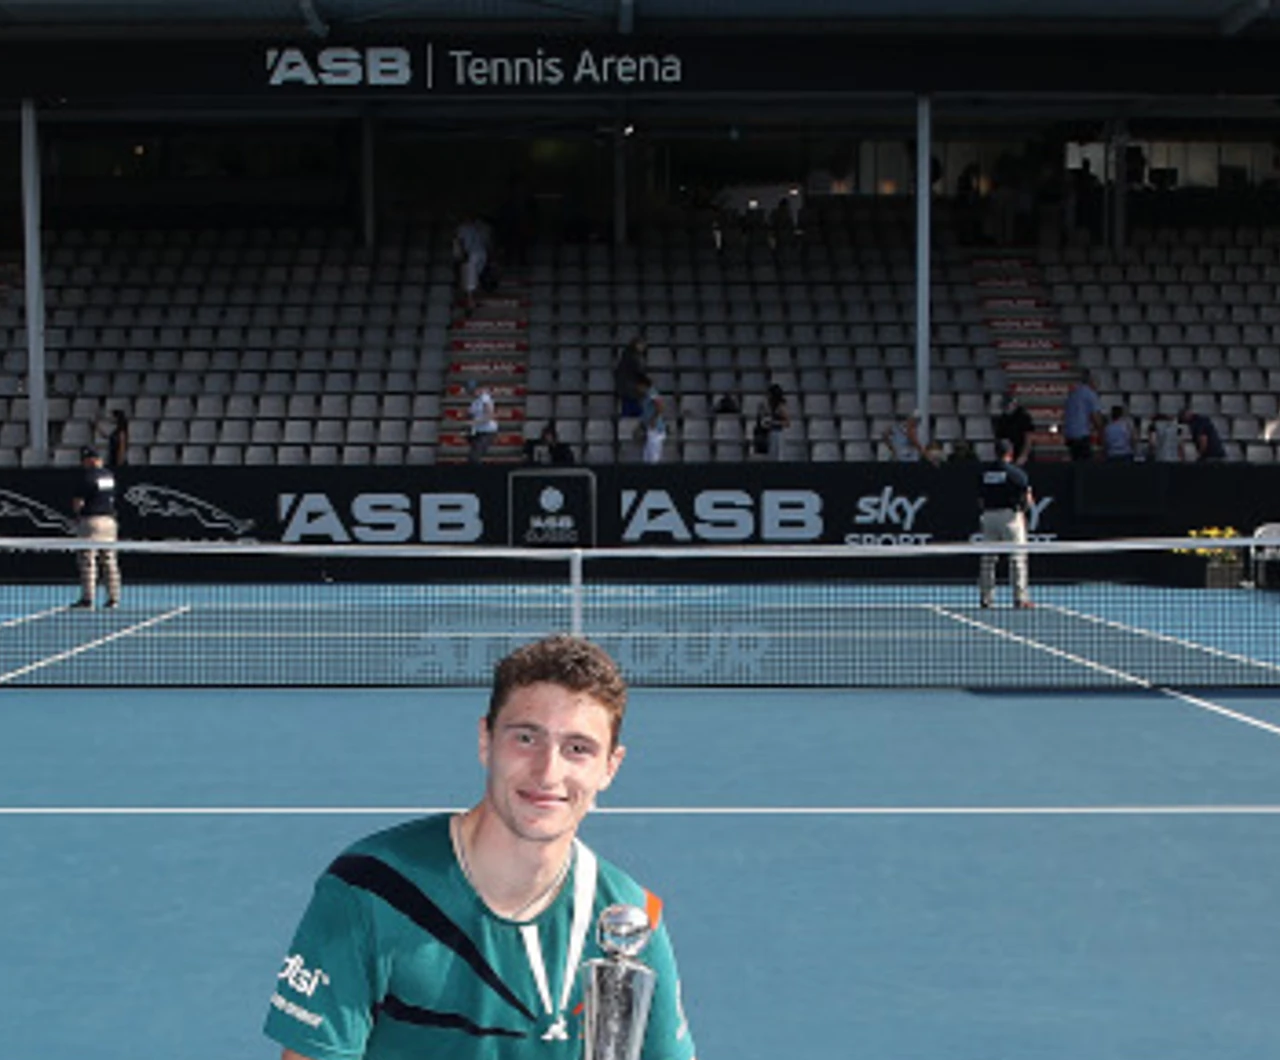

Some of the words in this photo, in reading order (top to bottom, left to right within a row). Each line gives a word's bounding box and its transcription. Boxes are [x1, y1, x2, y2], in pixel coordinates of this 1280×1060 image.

[449, 50, 564, 85] Tennis
[573, 50, 682, 85] Arena
[854, 485, 927, 531] sky
